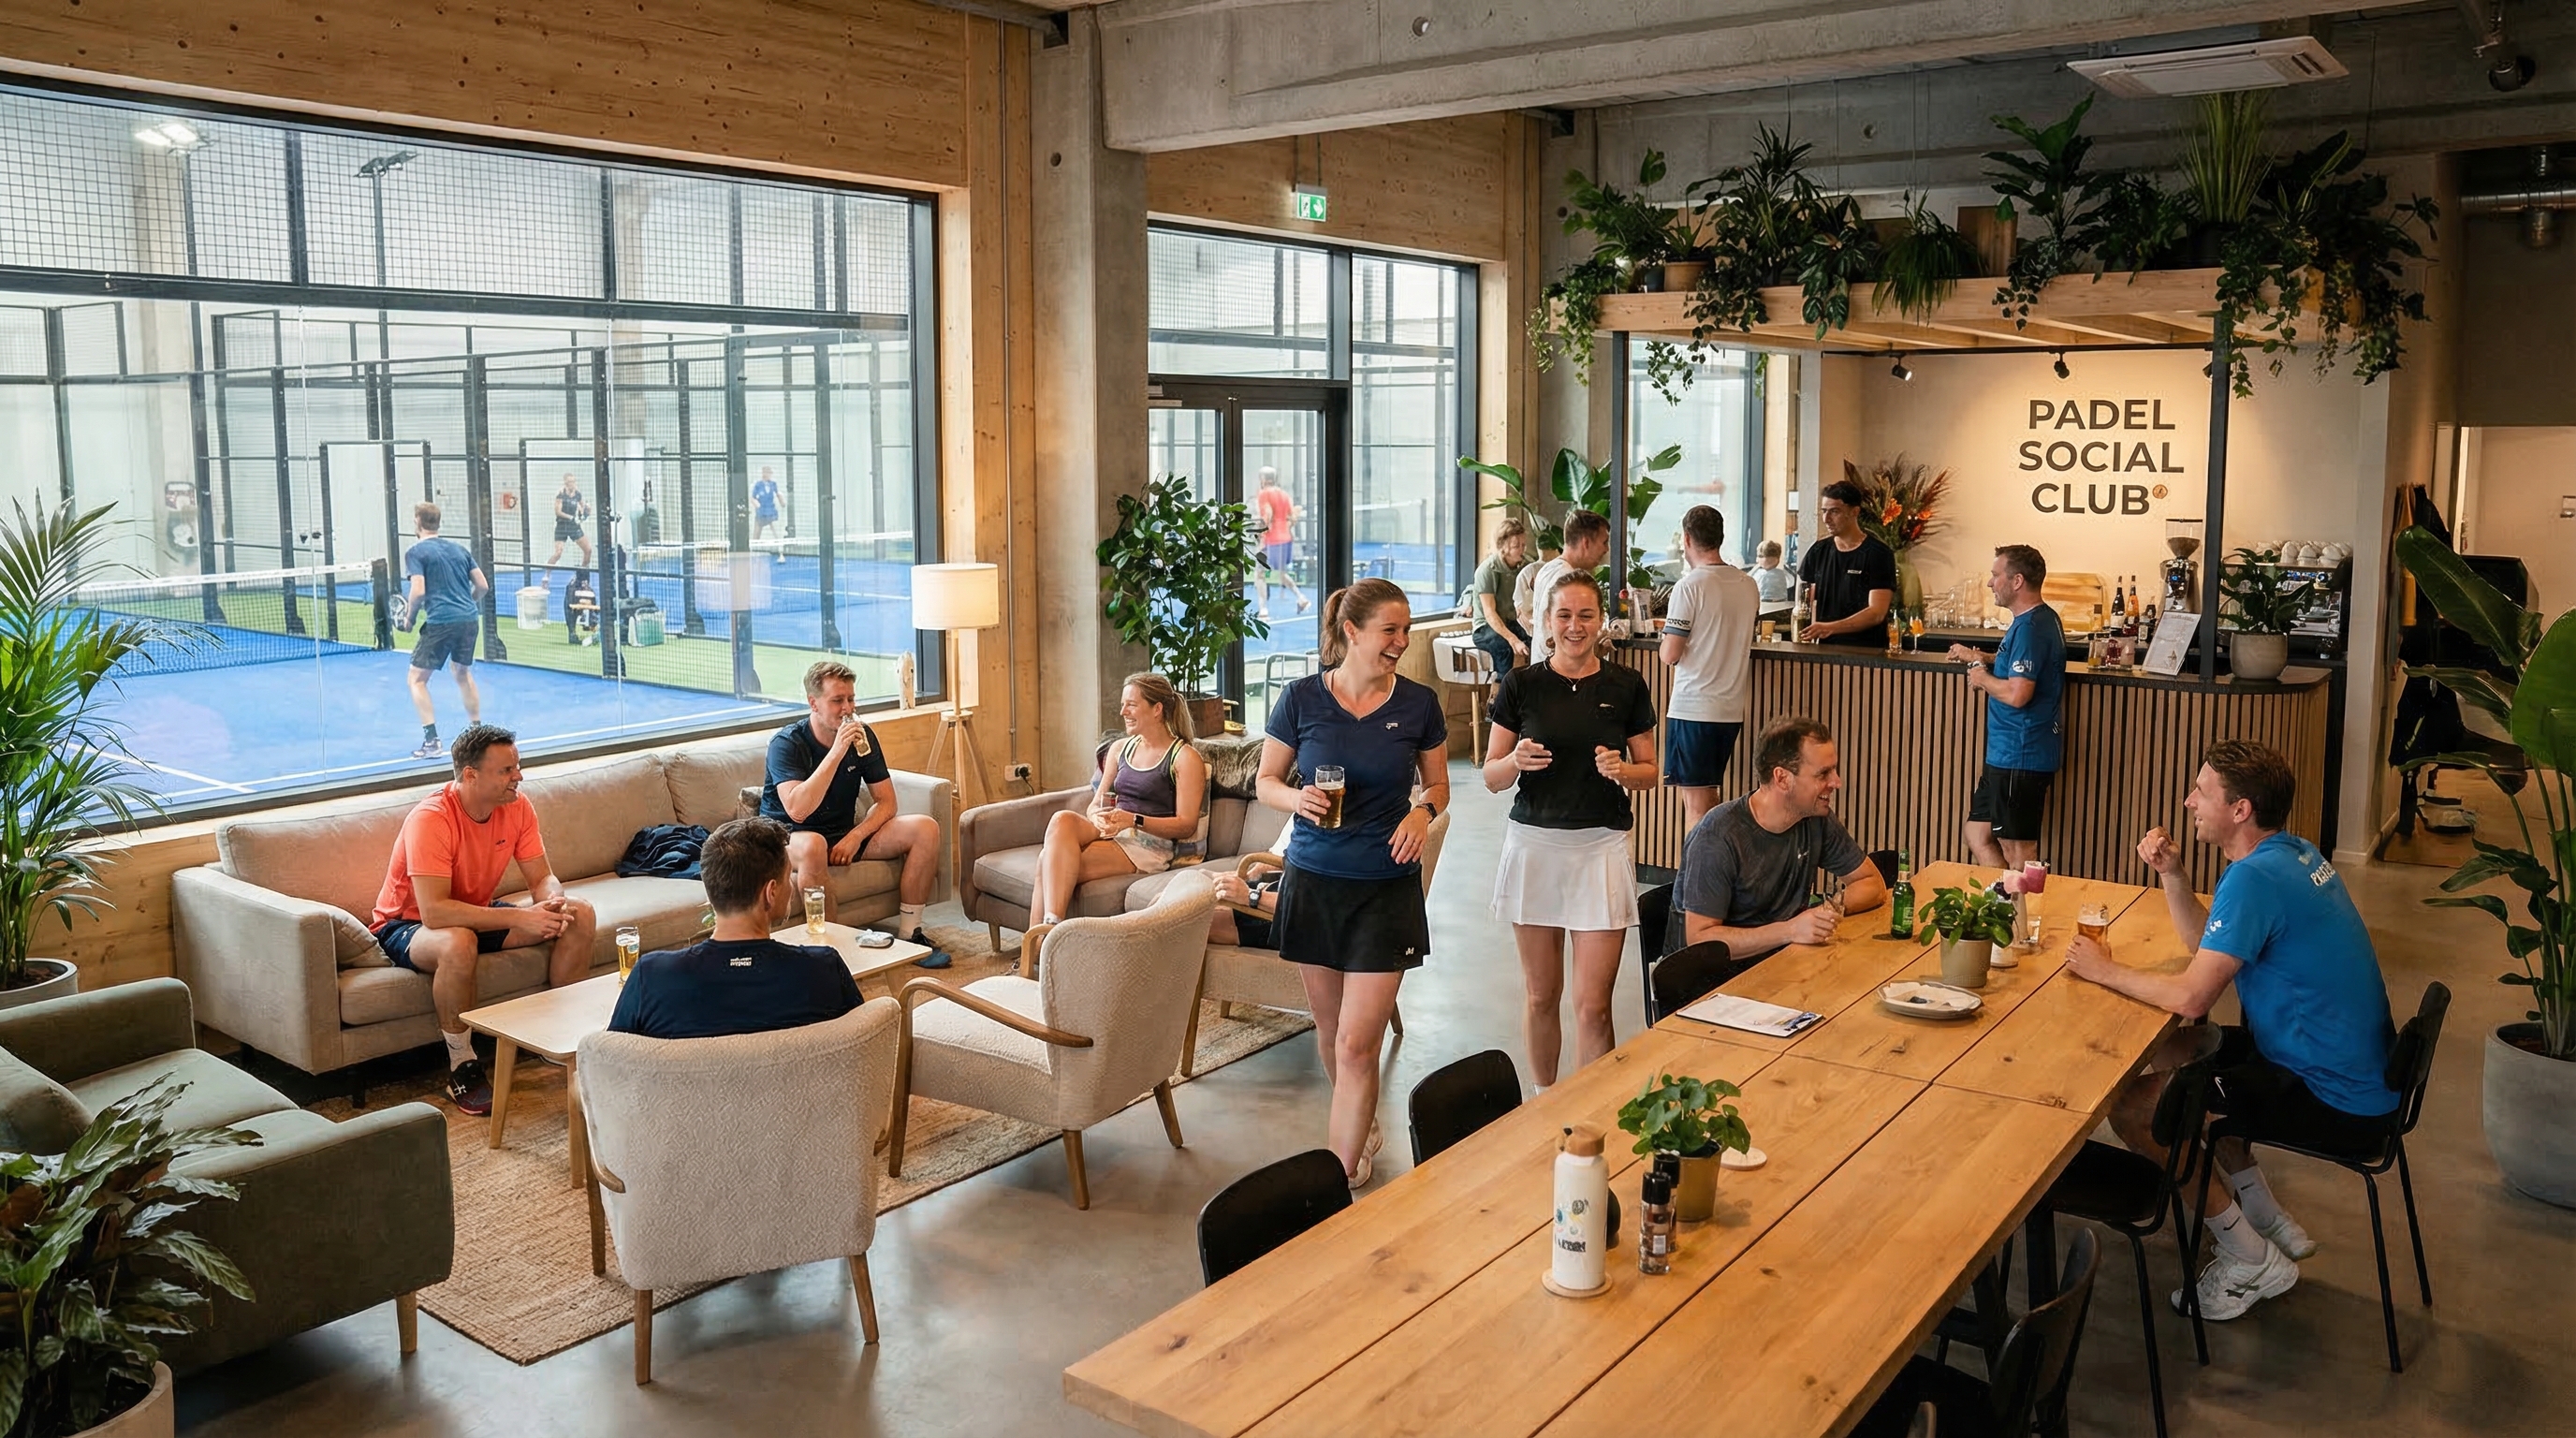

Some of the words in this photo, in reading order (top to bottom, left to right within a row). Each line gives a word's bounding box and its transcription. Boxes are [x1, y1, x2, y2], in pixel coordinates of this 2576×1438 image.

[2028, 399, 2175, 431] PADEL
[2018, 440, 2184, 474] SOCIAL
[2031, 482, 2150, 515] CLUB
